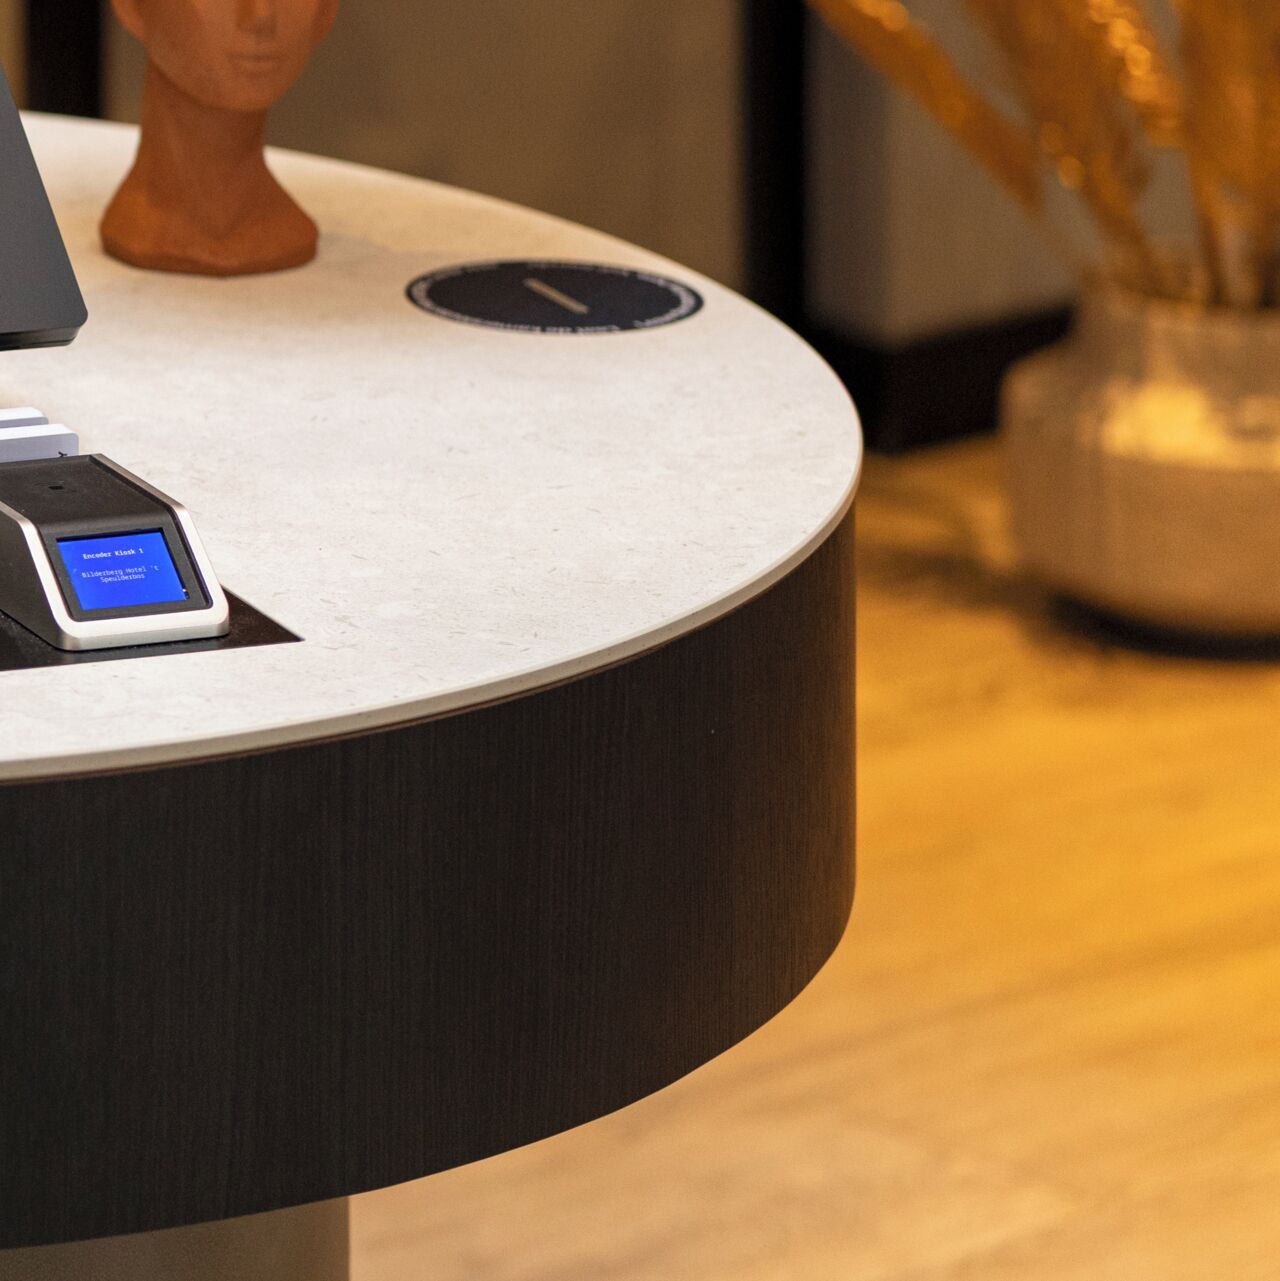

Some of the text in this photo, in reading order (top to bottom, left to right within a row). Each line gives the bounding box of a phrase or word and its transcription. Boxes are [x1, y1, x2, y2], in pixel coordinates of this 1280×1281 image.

[82, 552, 112, 560] Encoder
[114, 548, 135, 556] Kiosk
[81, 569, 123, 577] Bilderberg
[100, 574, 144, 583] Speulderbos
